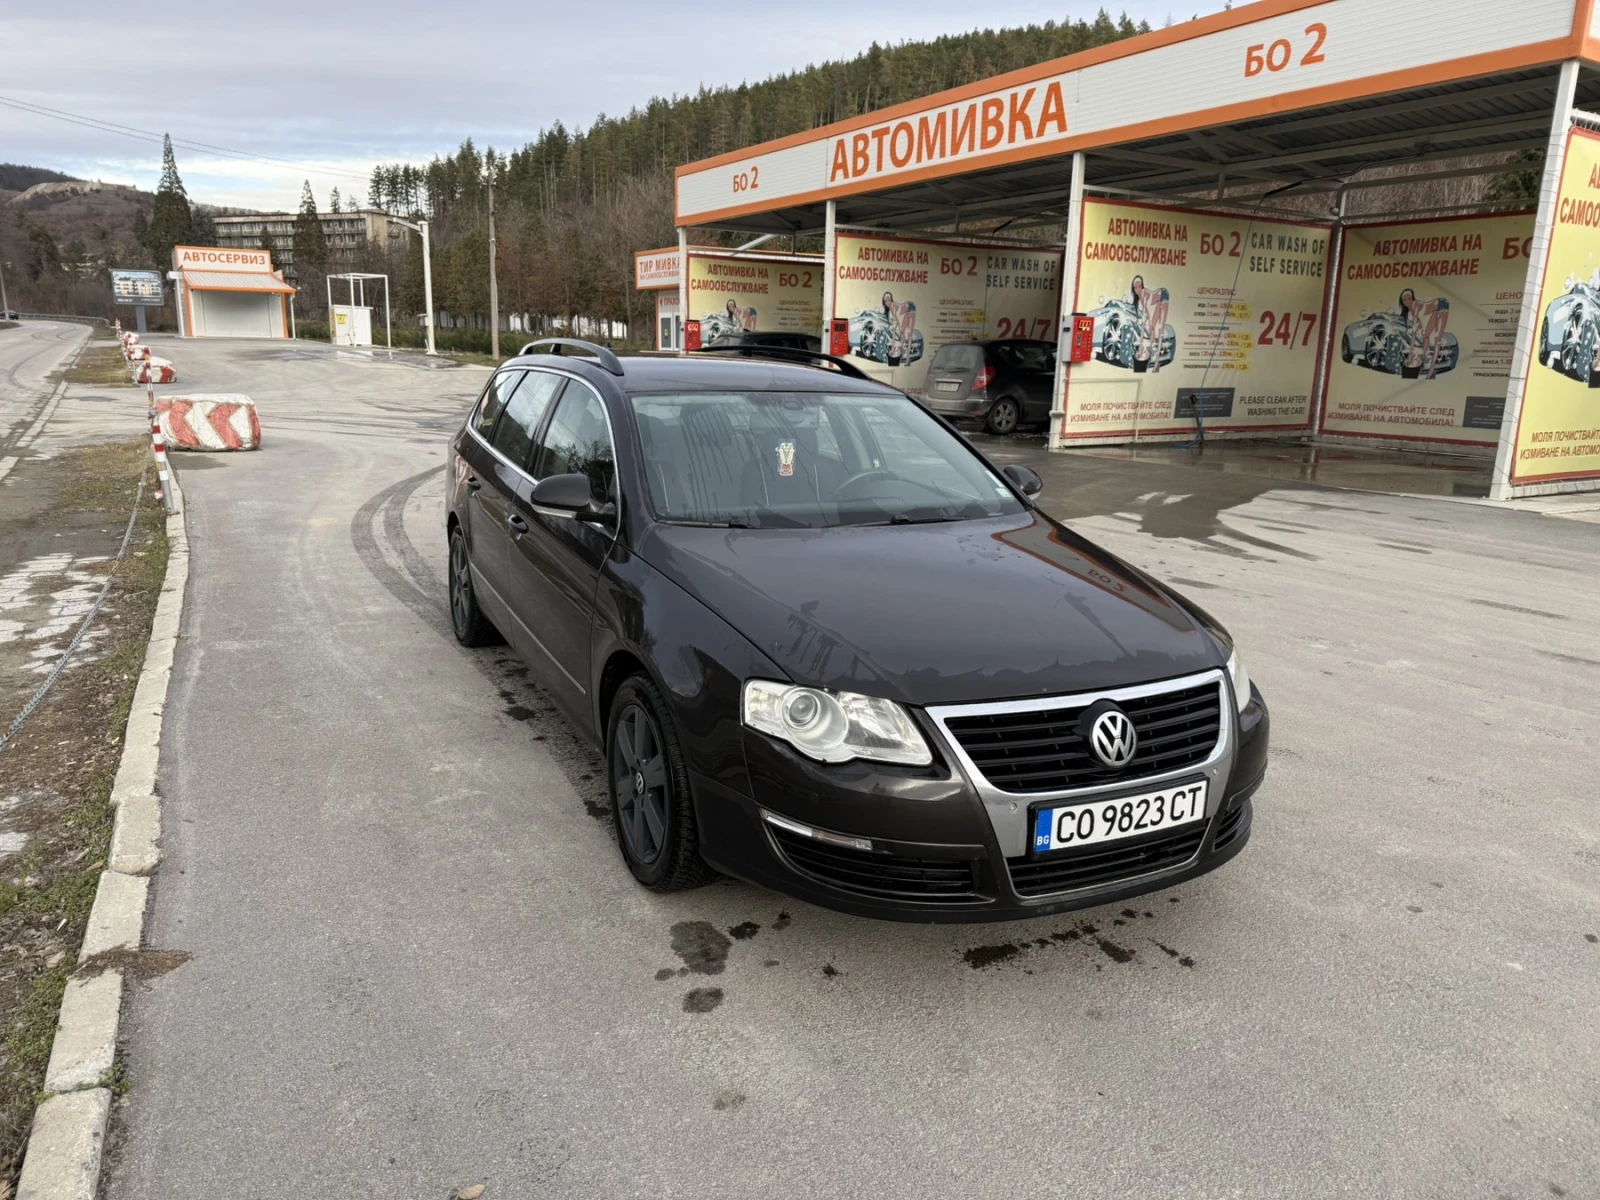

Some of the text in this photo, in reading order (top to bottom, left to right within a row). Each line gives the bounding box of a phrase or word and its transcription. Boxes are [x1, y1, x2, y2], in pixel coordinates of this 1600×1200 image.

[1244, 22, 1327, 77] БО 2
[830, 81, 1068, 183] АВТОМИВКА
[733, 165, 758, 193] БО 2
[1560, 197, 1600, 228] САМОО
[1107, 217, 1188, 242] АВТОМИВКА НА
[1200, 231, 1241, 257] БО 2
[1251, 232, 1324, 255] CAR WASH OF
[1373, 234, 1482, 257] АВТОМИВКА НА
[183, 251, 266, 265] АВТОСЕРВИЗ
[858, 247, 929, 265] АВТОМИВКА НА
[1085, 242, 1187, 266] САМООБСЛУЖВАНЕ
[640, 260, 653, 273] ТИР
[707, 264, 768, 279] АВТОМИВКА НА
[941, 256, 978, 276] БО 2
[987, 256, 1056, 272] CAR WASH OF
[1250, 255, 1322, 278] SELF SERVICE
[1347, 258, 1479, 280] САМООБСЛУЖВАНЕ
[646, 270, 680, 280] САМООБСЛУЖВАН
[779, 272, 799, 288] БО
[802, 271, 812, 288] 2
[839, 266, 928, 284] САМООБСЛУЖВАНЕ
[986, 275, 1054, 290] SELF SERVICE
[691, 278, 768, 294] САМООБСЛУЖВАНЕ
[1197, 286, 1236, 296] ЦЕНОРАЗПИС
[1496, 291, 1523, 301] ЦЕНО
[1258, 310, 1317, 350] 24/7
[1080, 402, 1102, 411] МОЛЯ
[1103, 400, 1152, 411] ПОЧИСТВАЙТЕ
[1154, 401, 1172, 409] СЛЕД
[1239, 395, 1307, 404] PLEASE CLEAN AFTER
[1071, 413, 1110, 422] ИЗМИВАНЕ
[1111, 412, 1121, 420] НА
[1247, 407, 1277, 416] WASHING
[1278, 407, 1290, 415] THE
[1338, 402, 1455, 417] МОЛЯ ПОЧИСТВАЙТЕ СЛЕД
[1328, 412, 1371, 421] ИЗМИВАНЕ
[1387, 416, 1454, 426] АВТОМОБИЛА!
[1531, 428, 1600, 443] МОЛЯ ПОЧИСТВАЙТ
[1520, 444, 1600, 460] ИЗМИВАНЕ НА АВТОМО
[1056, 786, 1202, 843] CO 9823 CT
[1037, 835, 1050, 846] BG
